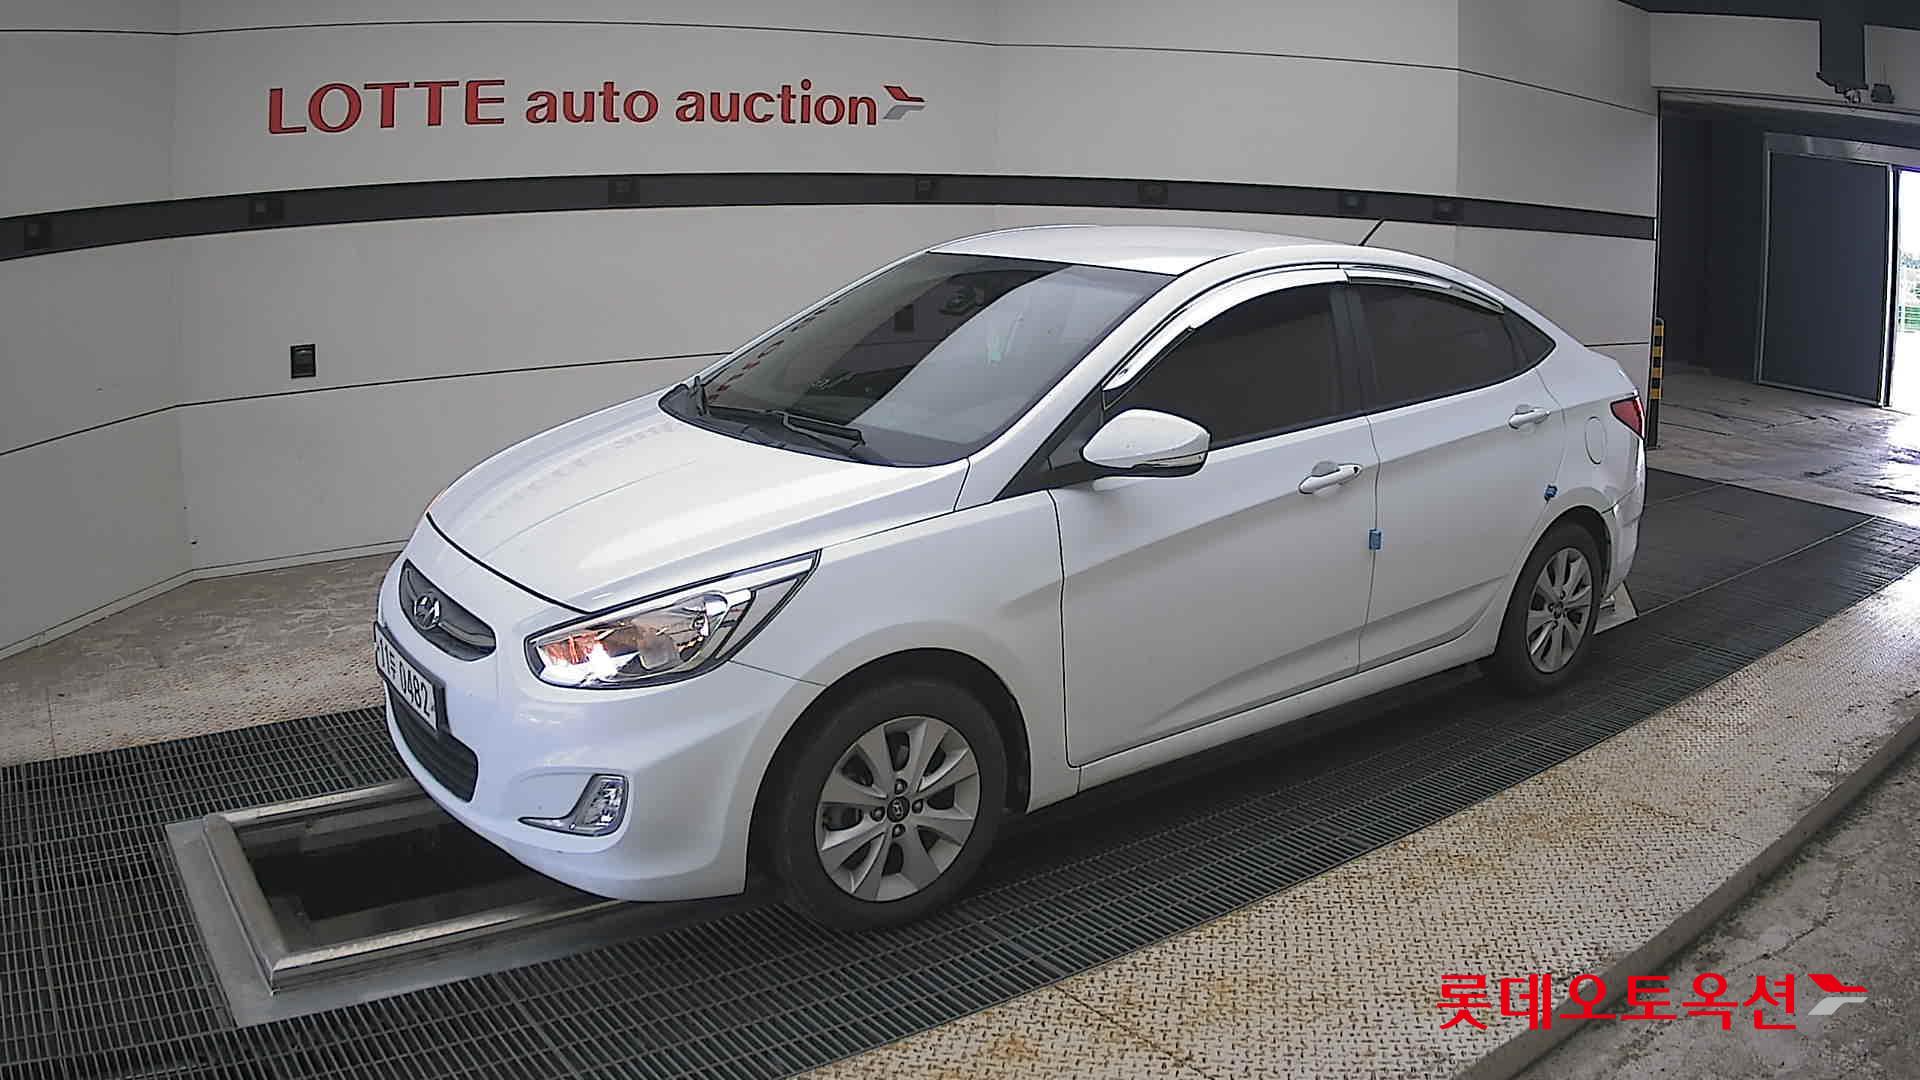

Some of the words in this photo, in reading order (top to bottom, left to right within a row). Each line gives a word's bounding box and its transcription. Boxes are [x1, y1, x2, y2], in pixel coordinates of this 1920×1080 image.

[268, 80, 505, 135] LOTTE
[525, 81, 659, 124] auto
[674, 78, 878, 125] auction
[399, 660, 431, 717] 0482
